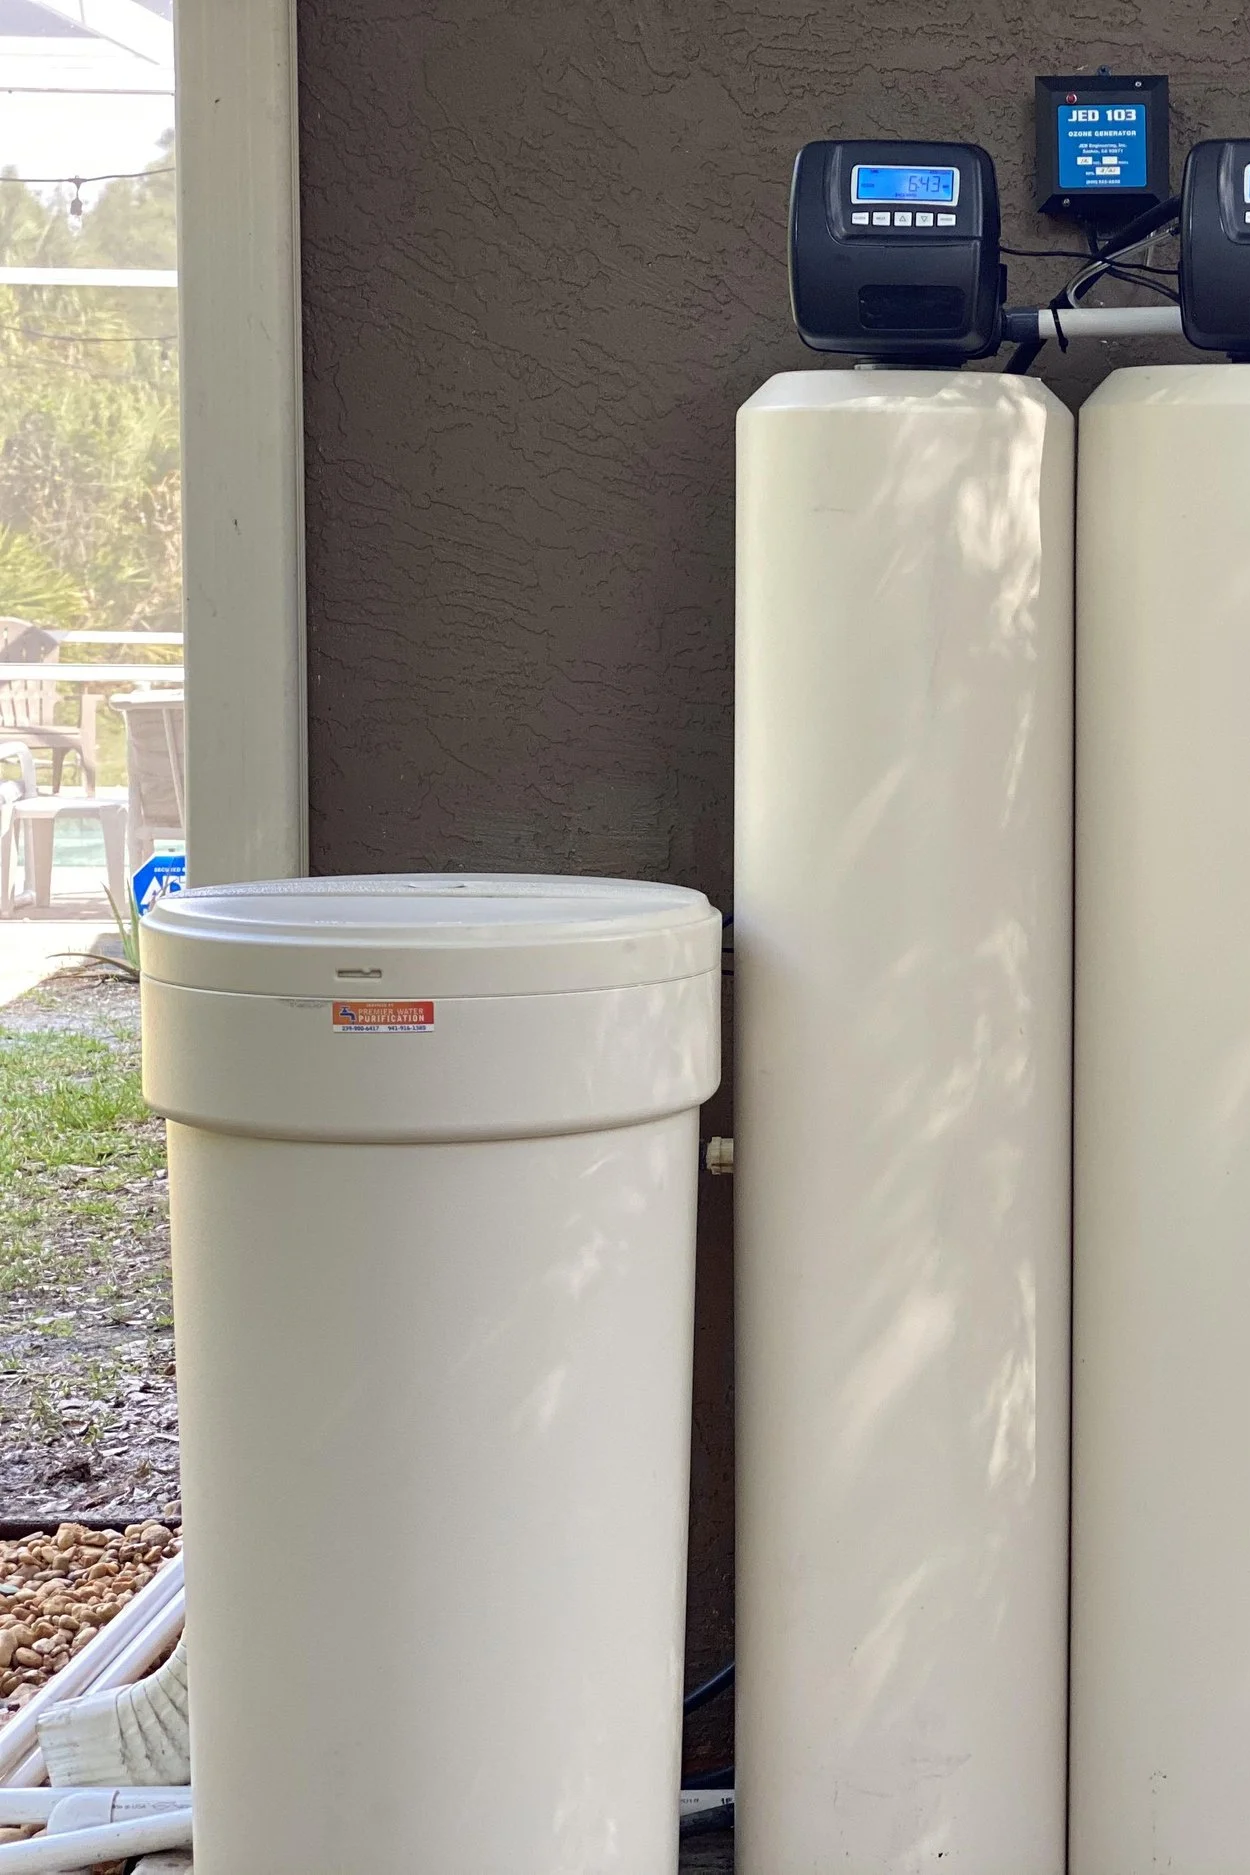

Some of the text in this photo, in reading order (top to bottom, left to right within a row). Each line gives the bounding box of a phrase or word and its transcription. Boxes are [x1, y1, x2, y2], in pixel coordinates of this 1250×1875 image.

[1067, 109, 1137, 122] JED 103
[396, 1007, 424, 1016] WATER
